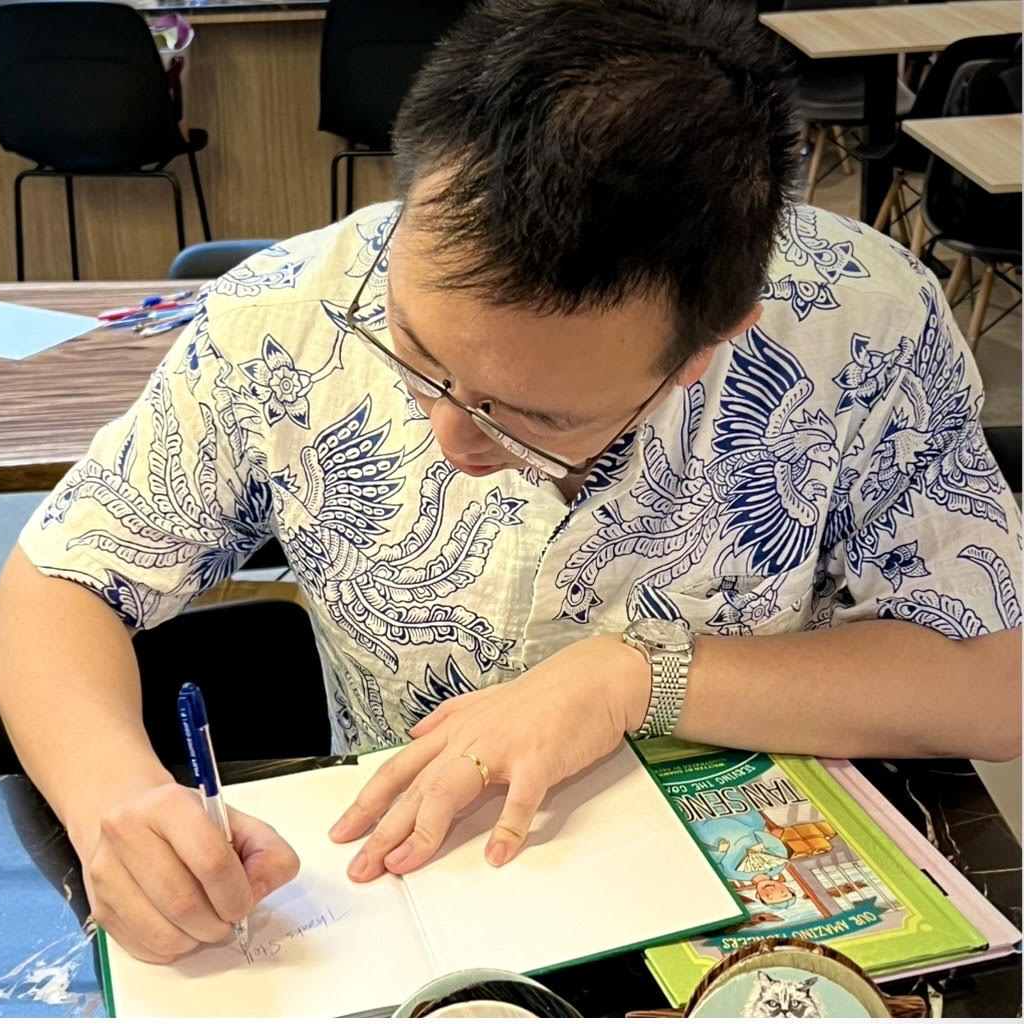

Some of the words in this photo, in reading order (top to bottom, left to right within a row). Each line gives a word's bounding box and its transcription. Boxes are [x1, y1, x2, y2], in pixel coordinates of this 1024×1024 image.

[717, 764, 756, 784] SERVING
[691, 779, 715, 791] THE
[738, 777, 809, 811] TAN
[286, 907, 352, 939] Thanks
[848, 910, 878, 927] OUR
[792, 919, 850, 942] AMAZING
